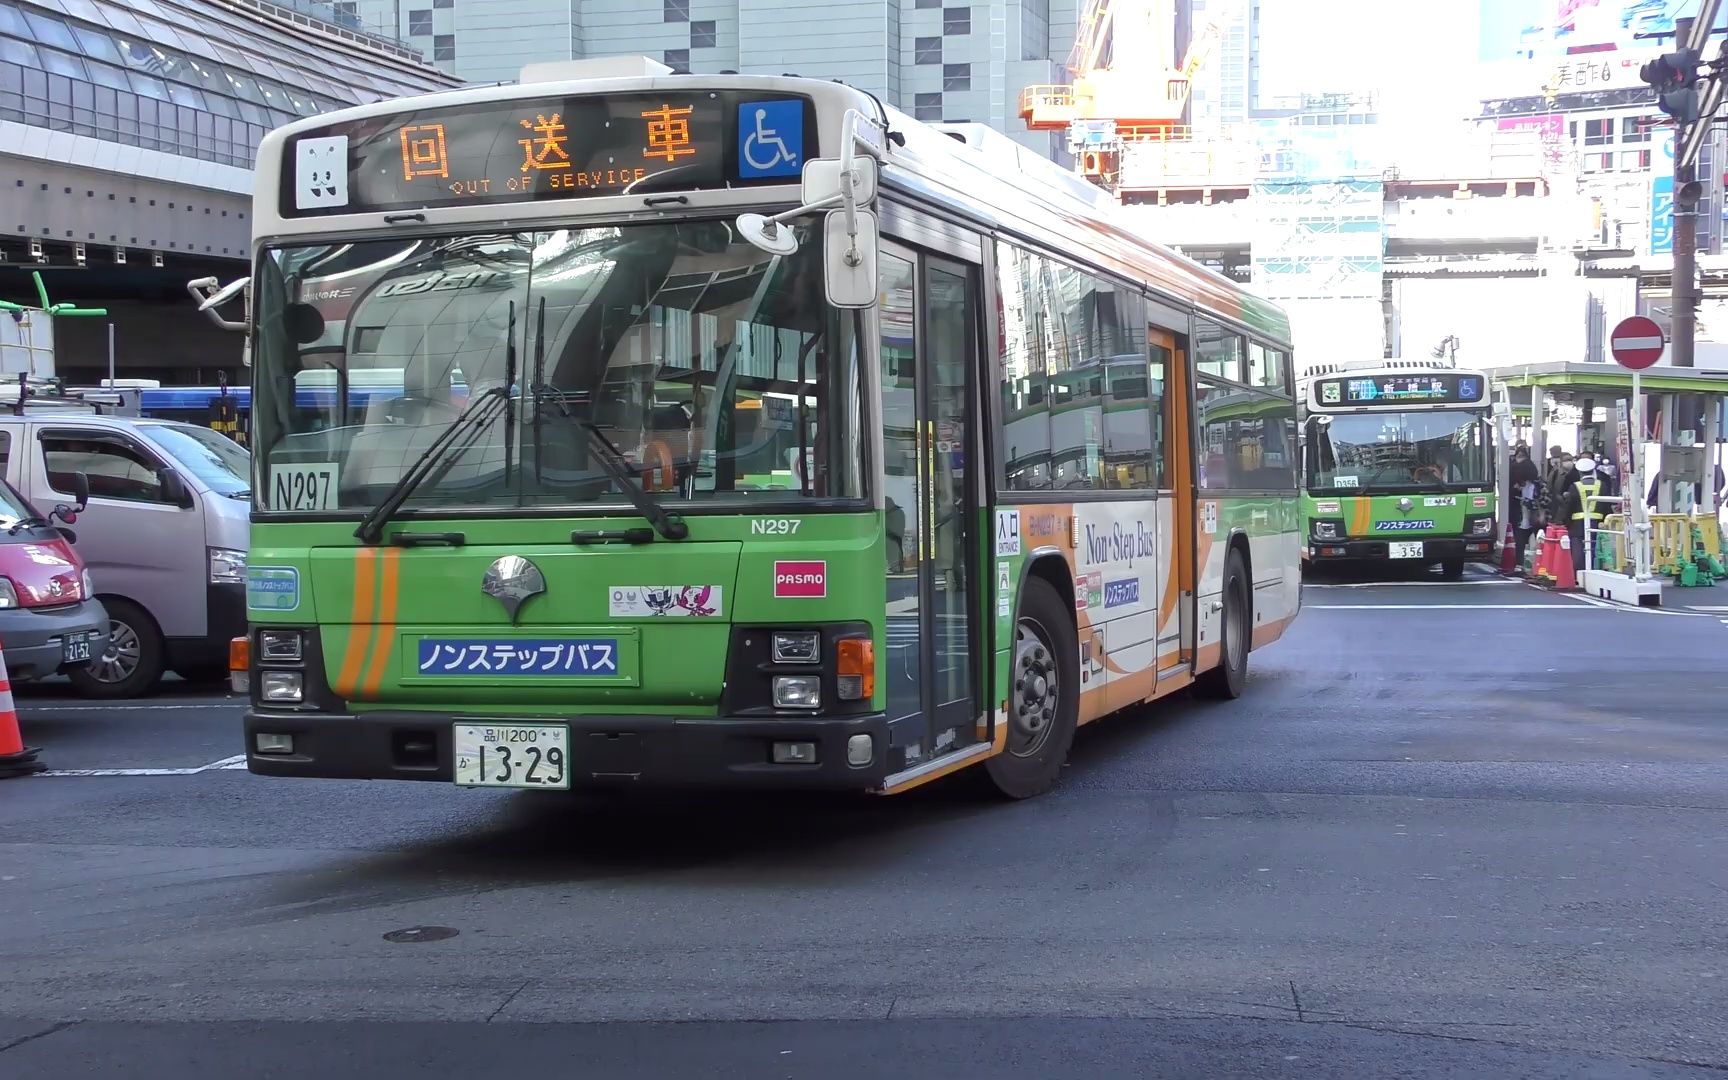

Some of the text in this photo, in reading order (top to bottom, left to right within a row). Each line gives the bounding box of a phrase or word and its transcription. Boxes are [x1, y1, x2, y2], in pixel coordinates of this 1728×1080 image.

[1557, 60, 1599, 86] 美酢
[400, 103, 696, 180] 回送車
[452, 167, 646, 194] OUT OF SERVICE
[276, 471, 331, 511] N297
[1336, 479, 1357, 488] D356
[751, 519, 801, 534] N297
[999, 513, 1018, 540] 入口
[1376, 520, 1434, 530] ノンステップバス
[999, 541, 1018, 554] ENTRANCE
[1136, 520, 1153, 559] Bus
[776, 574, 824, 585] PASMO
[1104, 581, 1139, 606] ノンステップバス
[69, 642, 90, 660] 21-52
[420, 644, 616, 670] ノンステップバス
[458, 745, 564, 783] か 13-29
